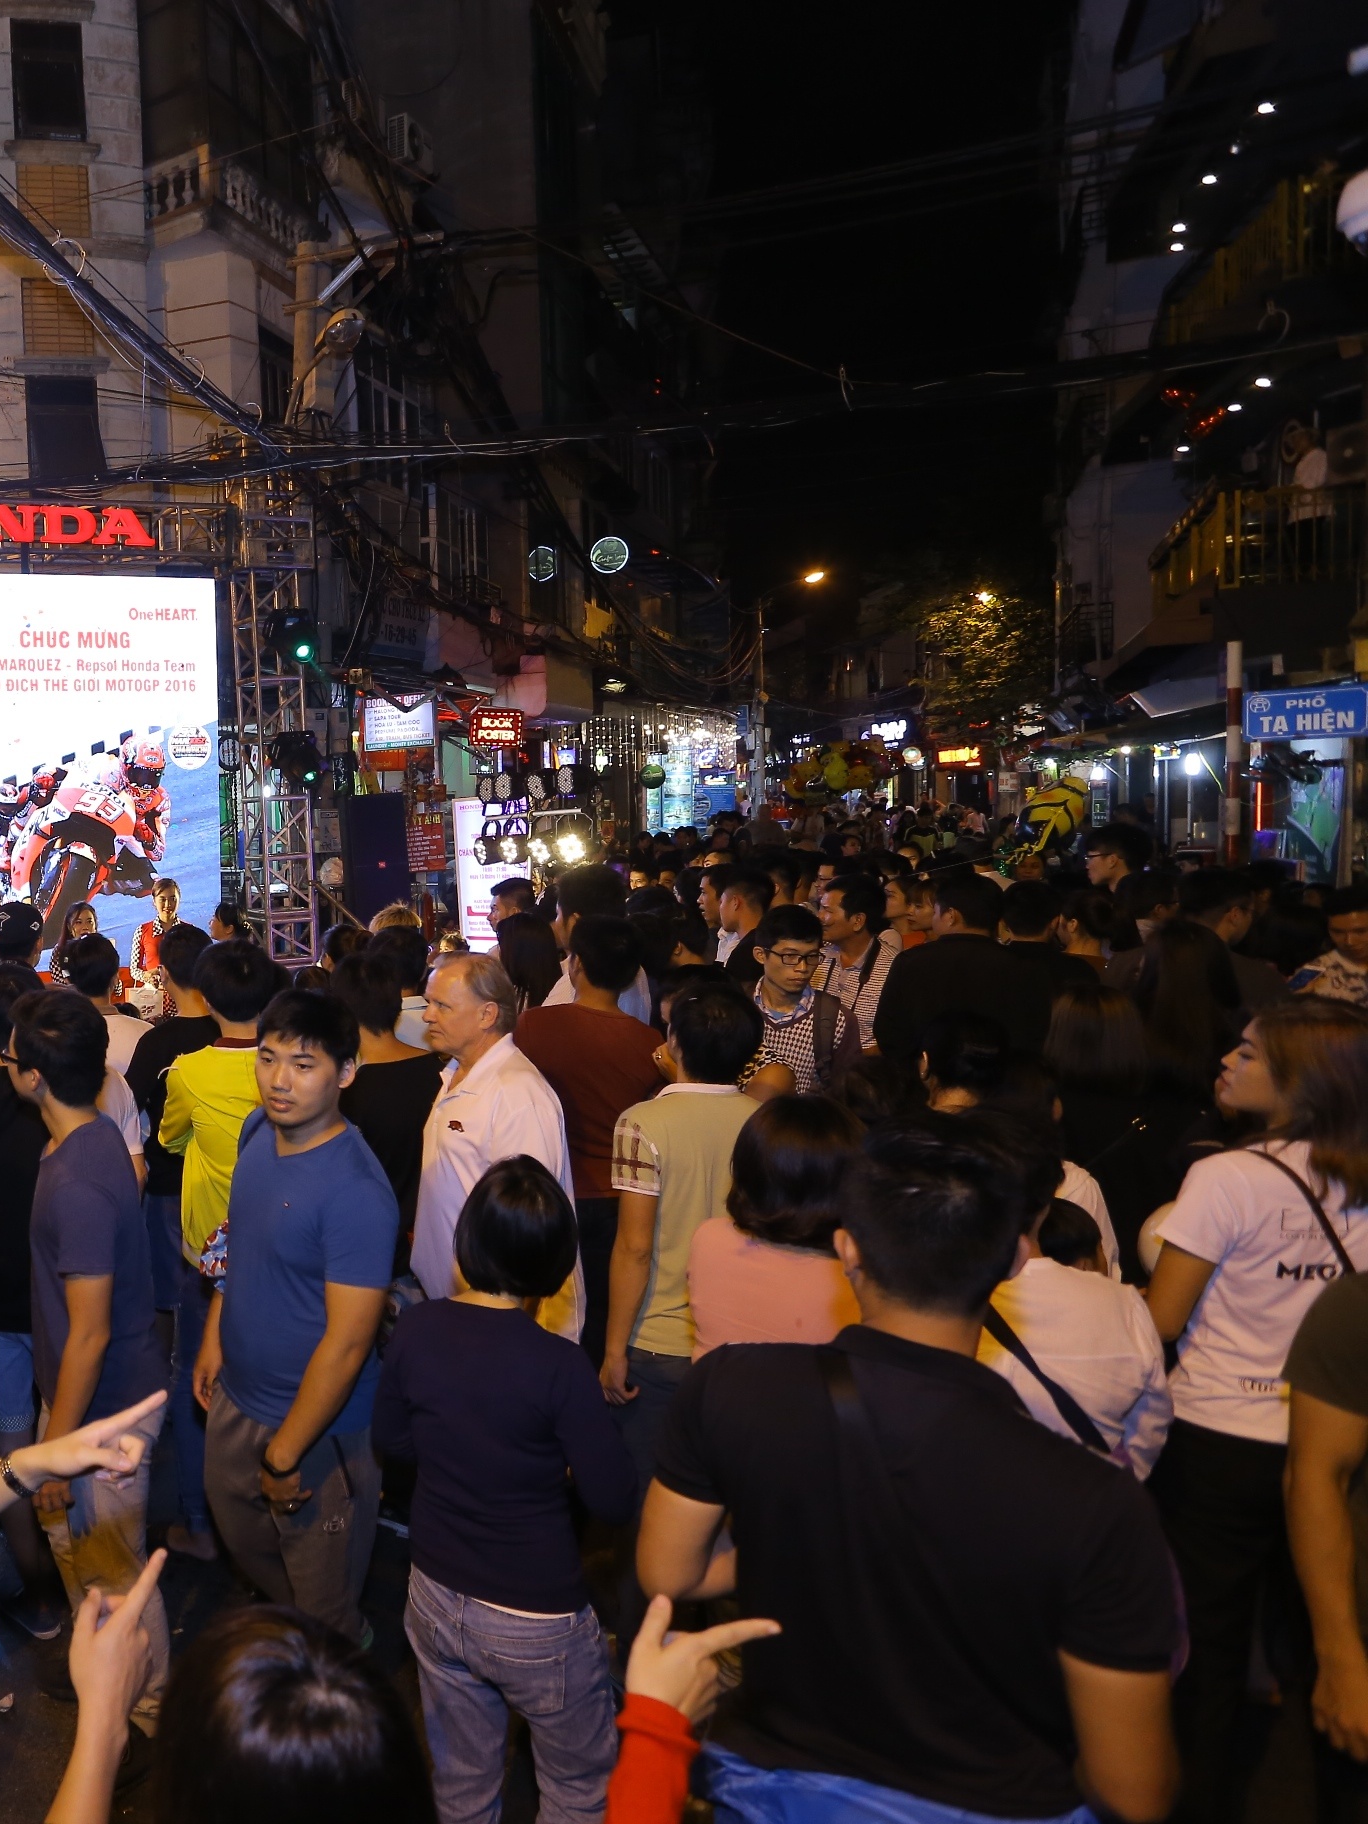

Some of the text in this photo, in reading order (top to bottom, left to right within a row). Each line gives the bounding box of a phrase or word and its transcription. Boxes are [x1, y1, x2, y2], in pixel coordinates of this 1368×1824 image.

[76, 659, 118, 674] Repsol
[121, 659, 160, 671] Honda
[163, 659, 196, 671] Team
[105, 679, 160, 691] MOTOGP
[164, 679, 196, 692] 2016
[1285, 693, 1326, 709] PHỐ
[481, 717, 513, 728] BOOK
[1259, 708, 1355, 735] TẠ HIỆN
[477, 729, 516, 740] POSTER
[73, 791, 125, 824] 93
